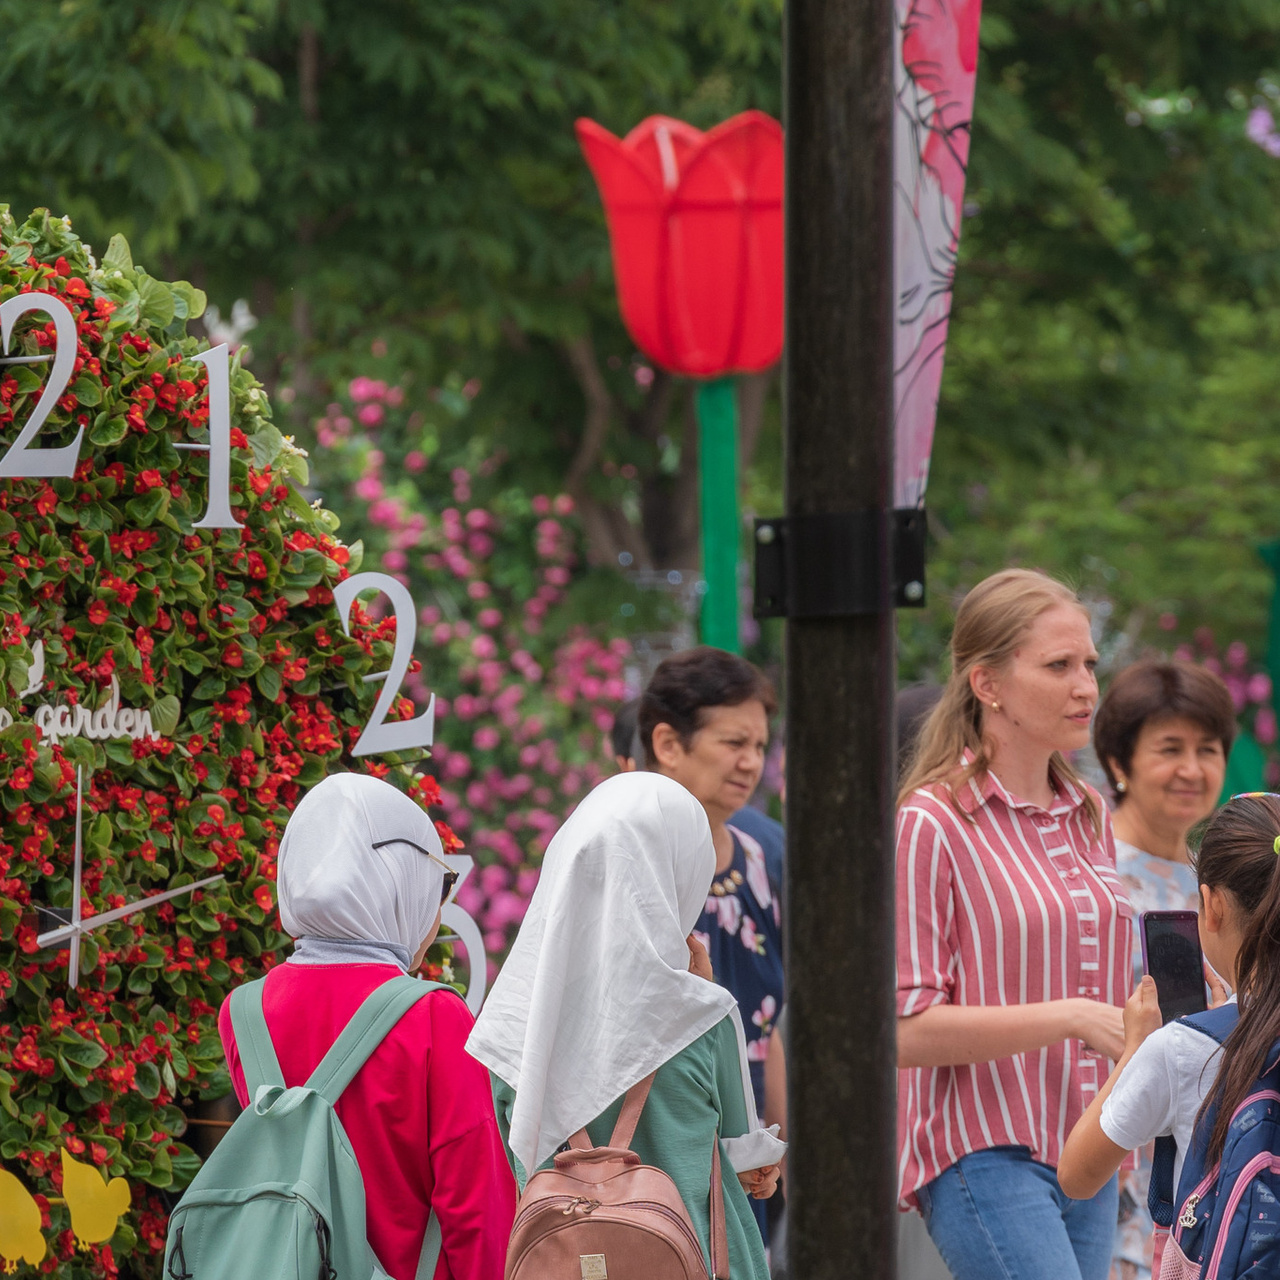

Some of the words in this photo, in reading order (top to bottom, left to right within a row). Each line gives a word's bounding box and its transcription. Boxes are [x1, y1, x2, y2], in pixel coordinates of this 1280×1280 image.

[193, 344, 245, 529] 1
[34, 674, 160, 747] garden
[334, 573, 436, 757] 2
